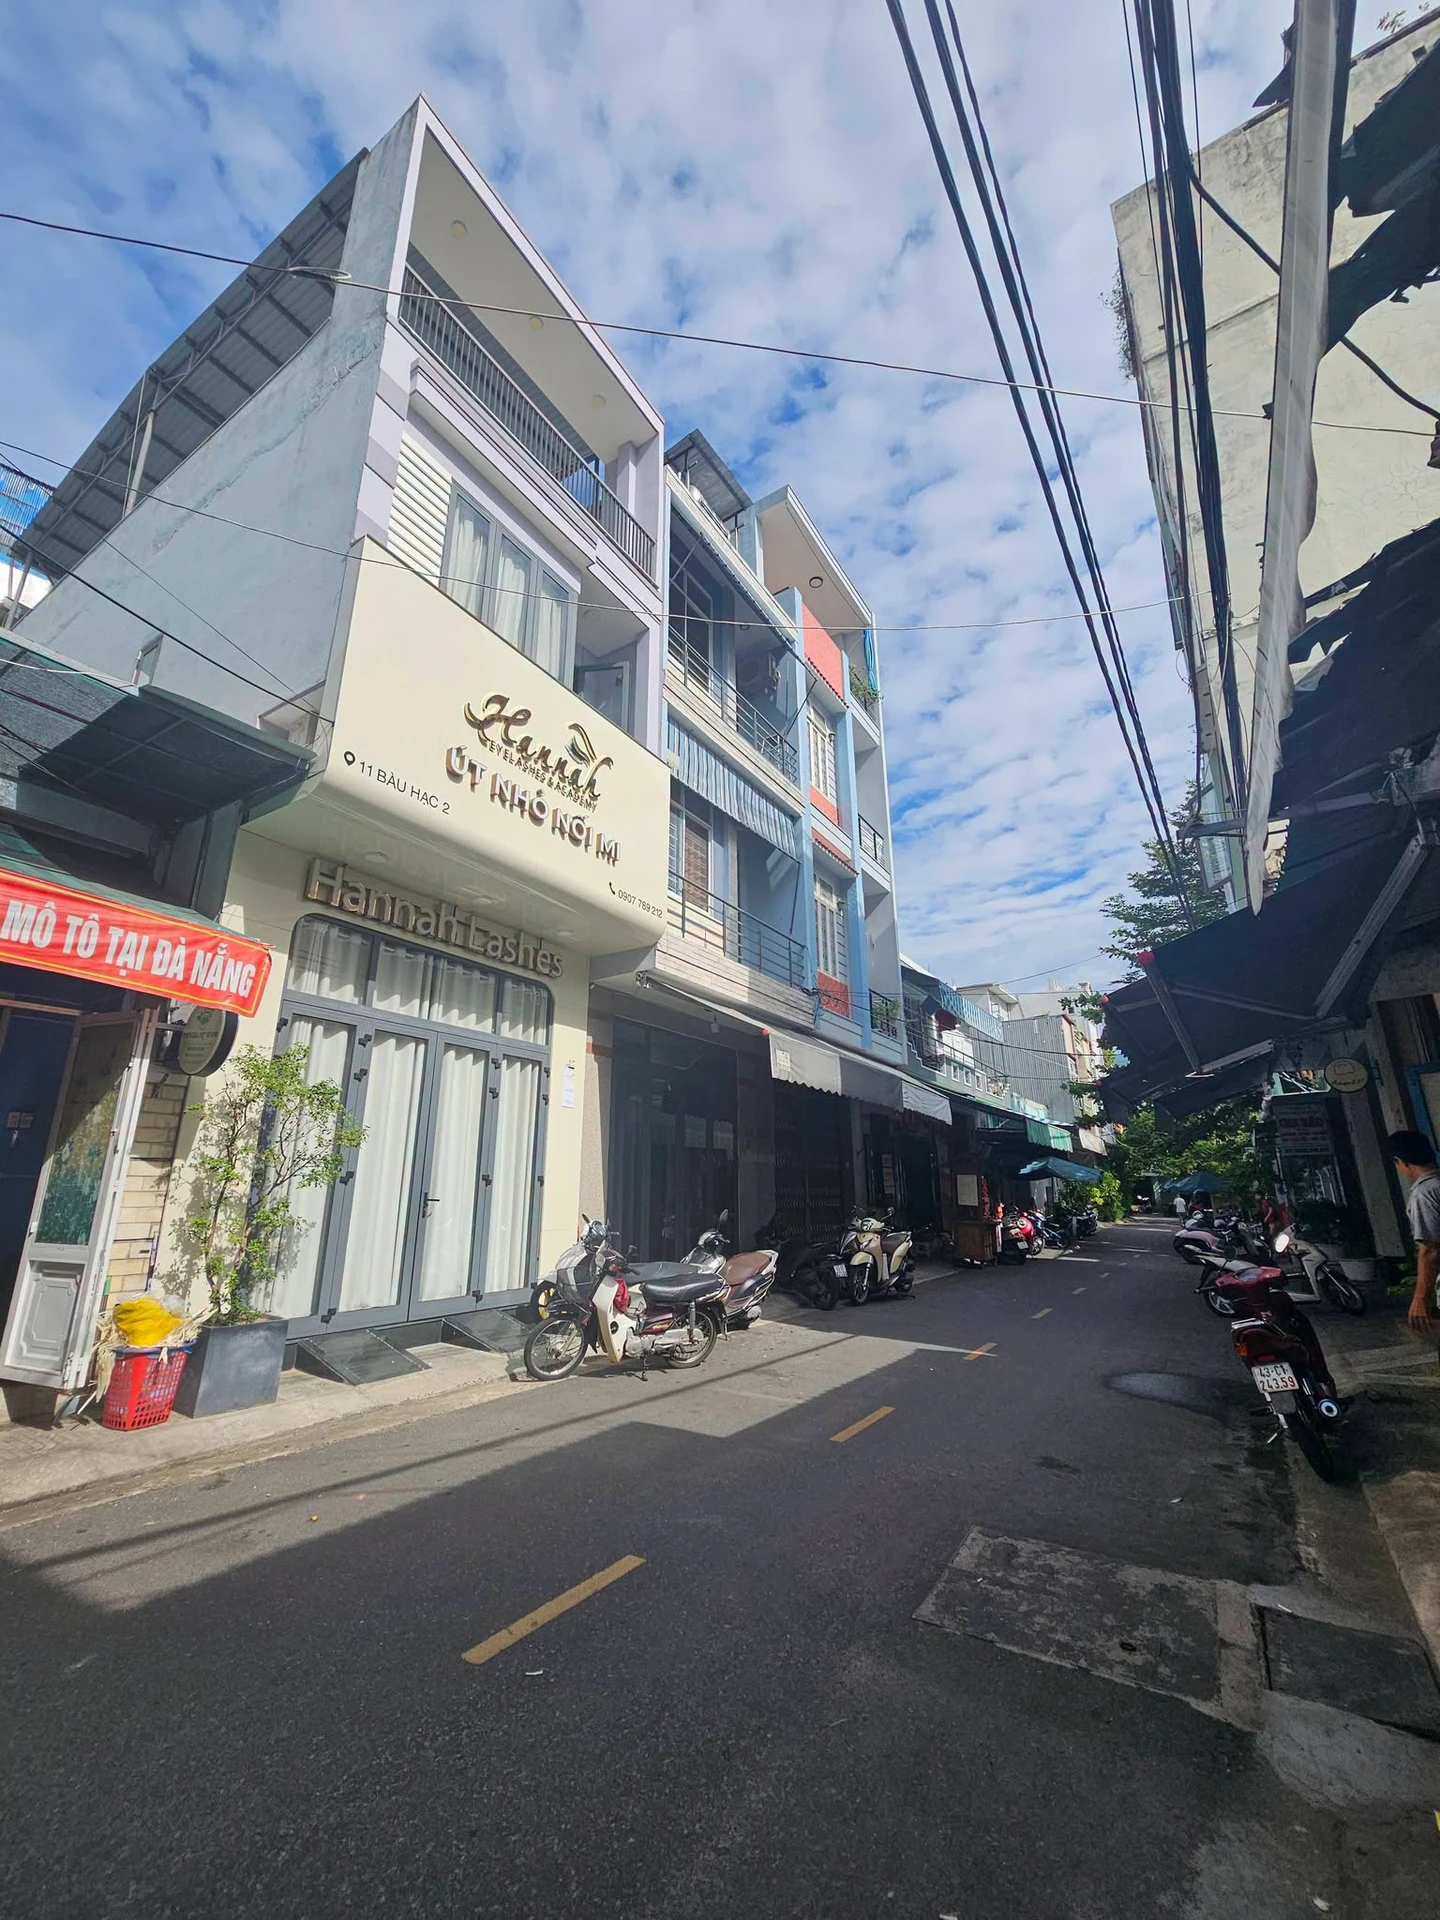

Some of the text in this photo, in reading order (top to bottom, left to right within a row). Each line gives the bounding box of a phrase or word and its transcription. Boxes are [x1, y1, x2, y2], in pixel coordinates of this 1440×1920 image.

[464, 694, 614, 801] Hannah
[489, 739, 598, 814] EYELASHES & ACADEMY
[360, 761, 450, 815] 11 BÀU HẠC 2
[490, 773, 549, 823] NHỎ
[596, 833, 621, 864] MI
[304, 858, 564, 979] Hannah Lashes
[618, 889, 637, 905] 0907
[651, 905, 663, 919] 212
[0, 900, 257, 998] MÔ TÔ TẠI ĐÀ NẴNG
[1259, 1364, 1287, 1378] 43-C1
[1260, 1376, 1296, 1392] 243.59
